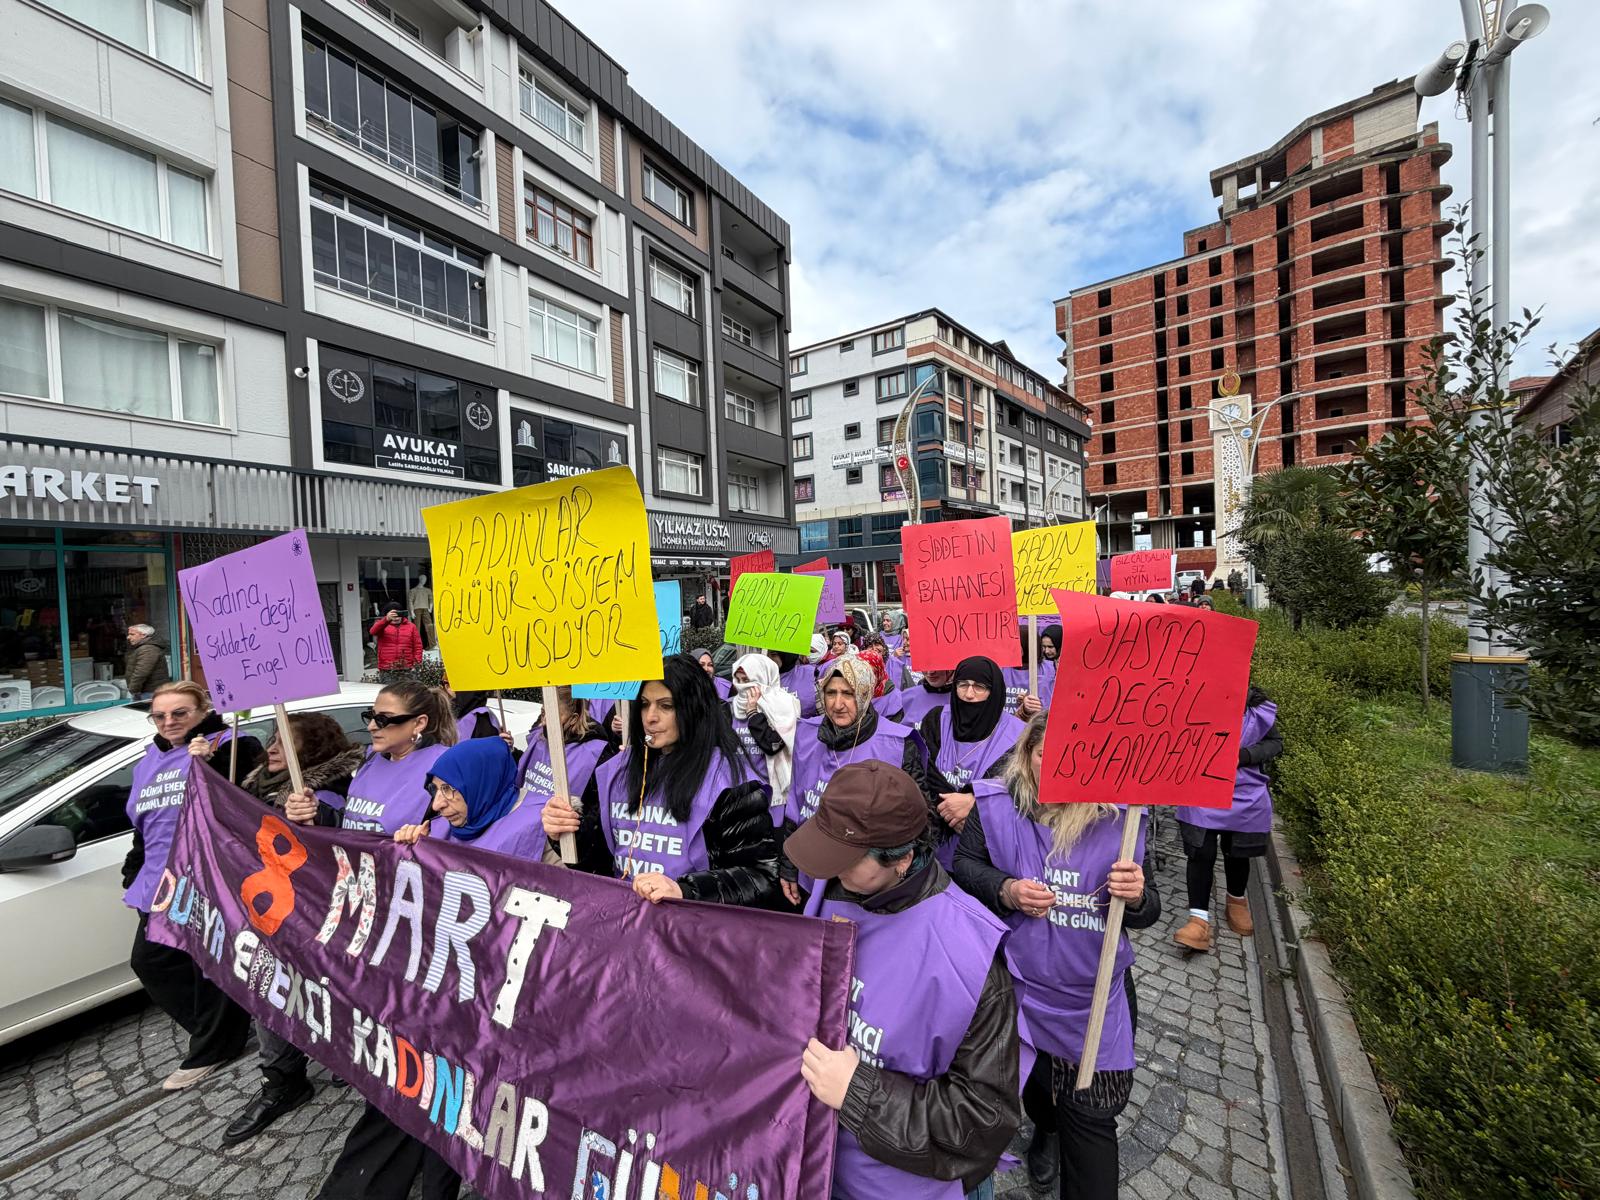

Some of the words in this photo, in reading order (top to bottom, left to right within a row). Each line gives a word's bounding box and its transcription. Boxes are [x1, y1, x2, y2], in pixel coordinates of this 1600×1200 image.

[383, 433, 458, 458] AVUKAT
[393, 452, 450, 466] ARABULUCU
[655, 518, 701, 536] YILMAZ
[704, 523, 731, 538] USTA
[661, 536, 682, 545] DÖNER
[687, 538, 705, 546] YEMEK
[705, 539, 726, 547] SALONU
[1017, 527, 1084, 565] KADIN
[186, 567, 262, 624] Kadına
[733, 577, 789, 609] KADINA
[917, 564, 1006, 603] BAHANESİ
[1083, 604, 1206, 678] YASTA
[241, 642, 288, 686] Engel
[1088, 675, 1211, 728] DEĞİL
[345, 795, 386, 817] ADINA
[1044, 865, 1081, 888] MART
[239, 815, 308, 936] 8
[314, 845, 572, 1029] MART
[352, 1007, 549, 1193] KADINLAR
